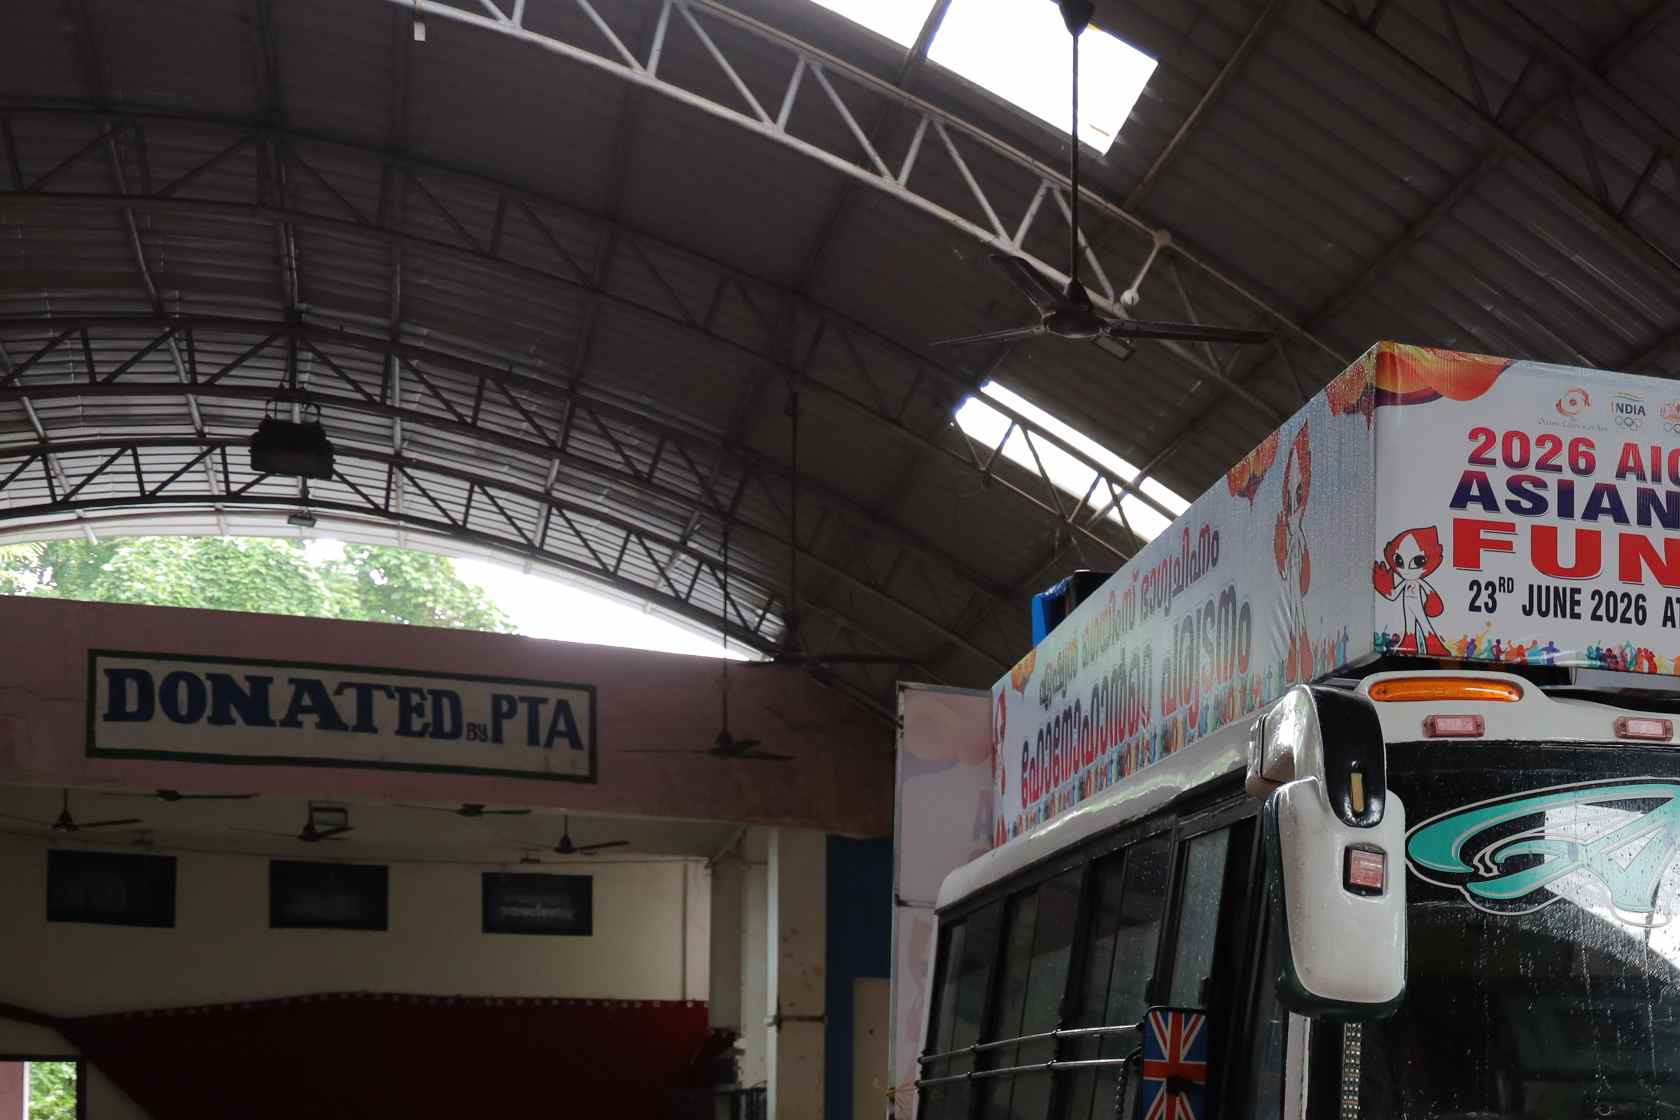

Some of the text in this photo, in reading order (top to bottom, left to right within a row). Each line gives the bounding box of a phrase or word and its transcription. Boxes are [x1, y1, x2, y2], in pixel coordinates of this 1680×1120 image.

[1611, 401, 1646, 417] INDIA
[1467, 427, 1597, 476] 2026
[1521, 583, 1583, 622] JUNE
[1590, 588, 1648, 627] 2026
[103, 668, 584, 750] DONATED BY PTA
